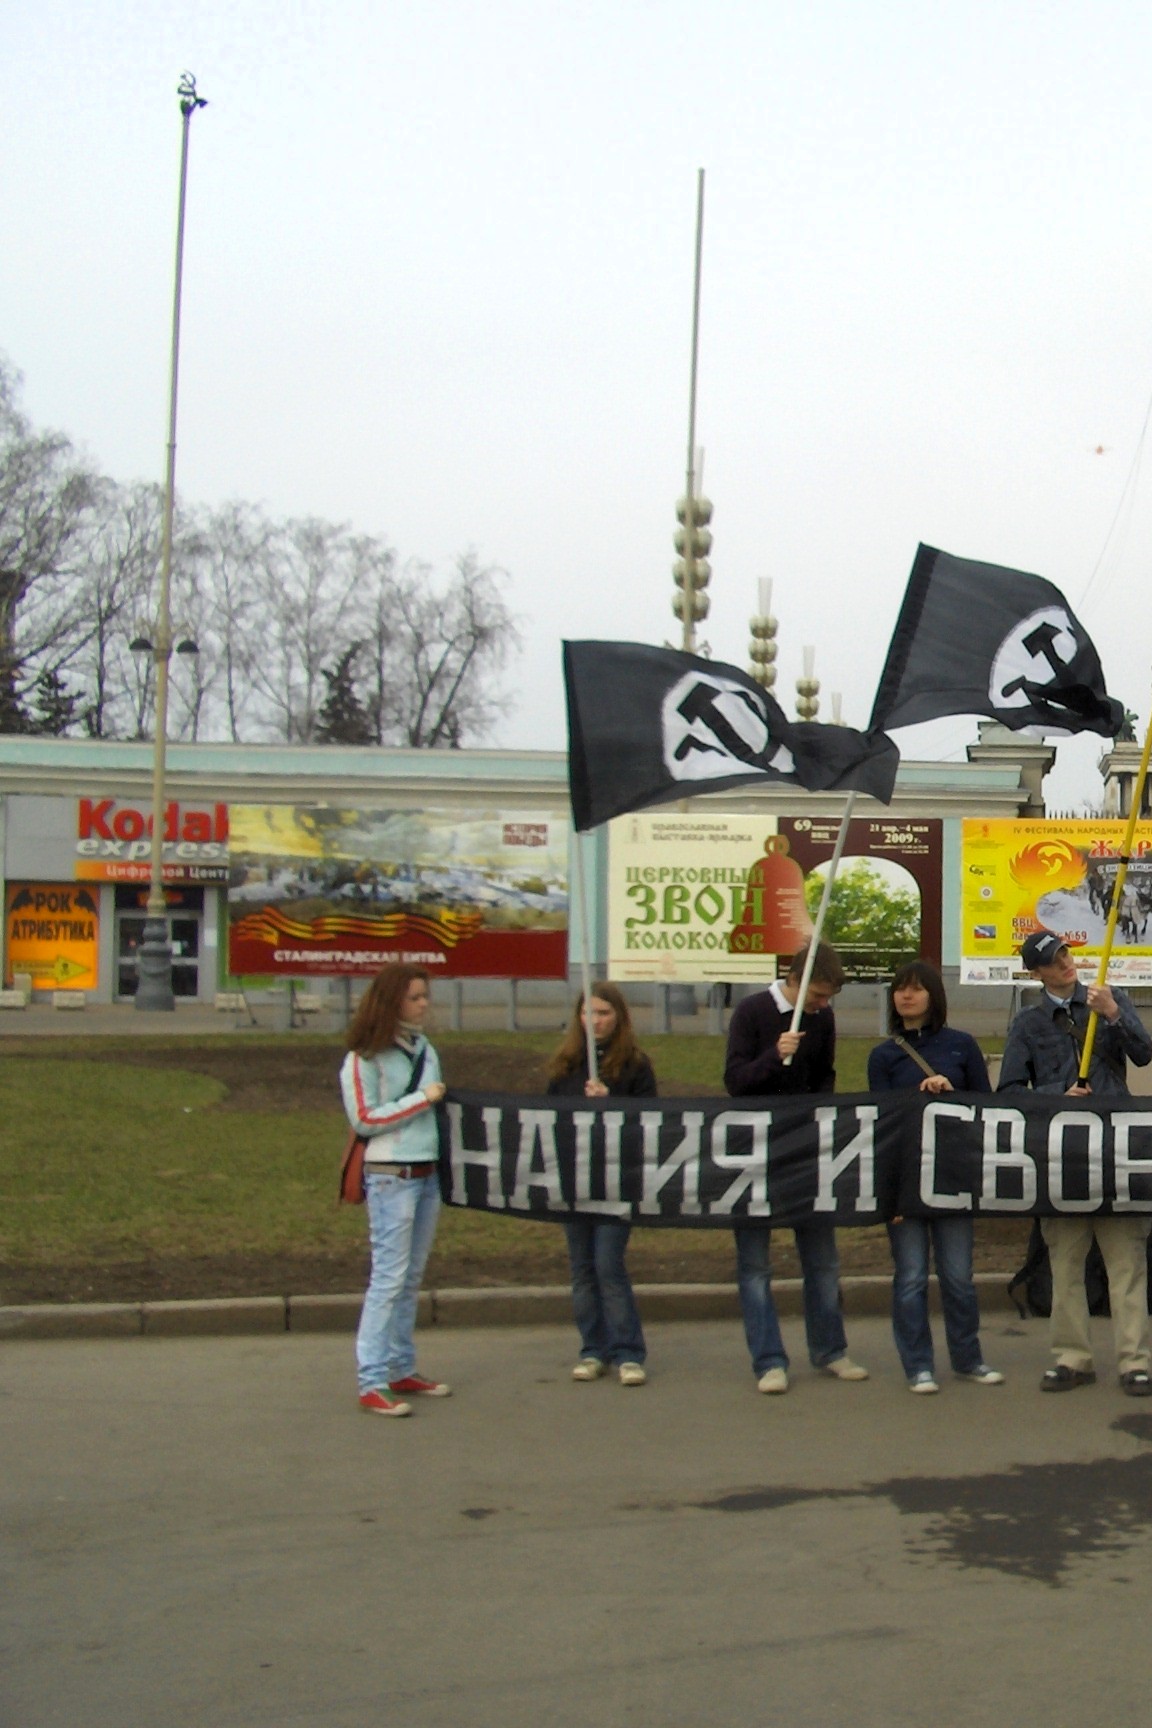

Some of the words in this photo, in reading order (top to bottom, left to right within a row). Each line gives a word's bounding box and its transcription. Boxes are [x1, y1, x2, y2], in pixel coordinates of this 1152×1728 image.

[793, 819, 812, 831] 69
[1025, 827, 1074, 835] ФЕСТИВАЛЬ
[884, 833, 914, 843] 2009
[77, 838, 230, 861] expres
[106, 864, 185, 879] Цифрой
[626, 866, 765, 884] ЦЕРКОВНЫЙ
[35, 892, 72, 913] РОК
[626, 884, 766, 929] ЗВОН
[11, 919, 95, 941] АТРИБУТИКА
[625, 930, 764, 951] КОЛОКОЛОВ
[446, 1102, 773, 1221] НАЦИЯ
[813, 1106, 879, 1212] И
